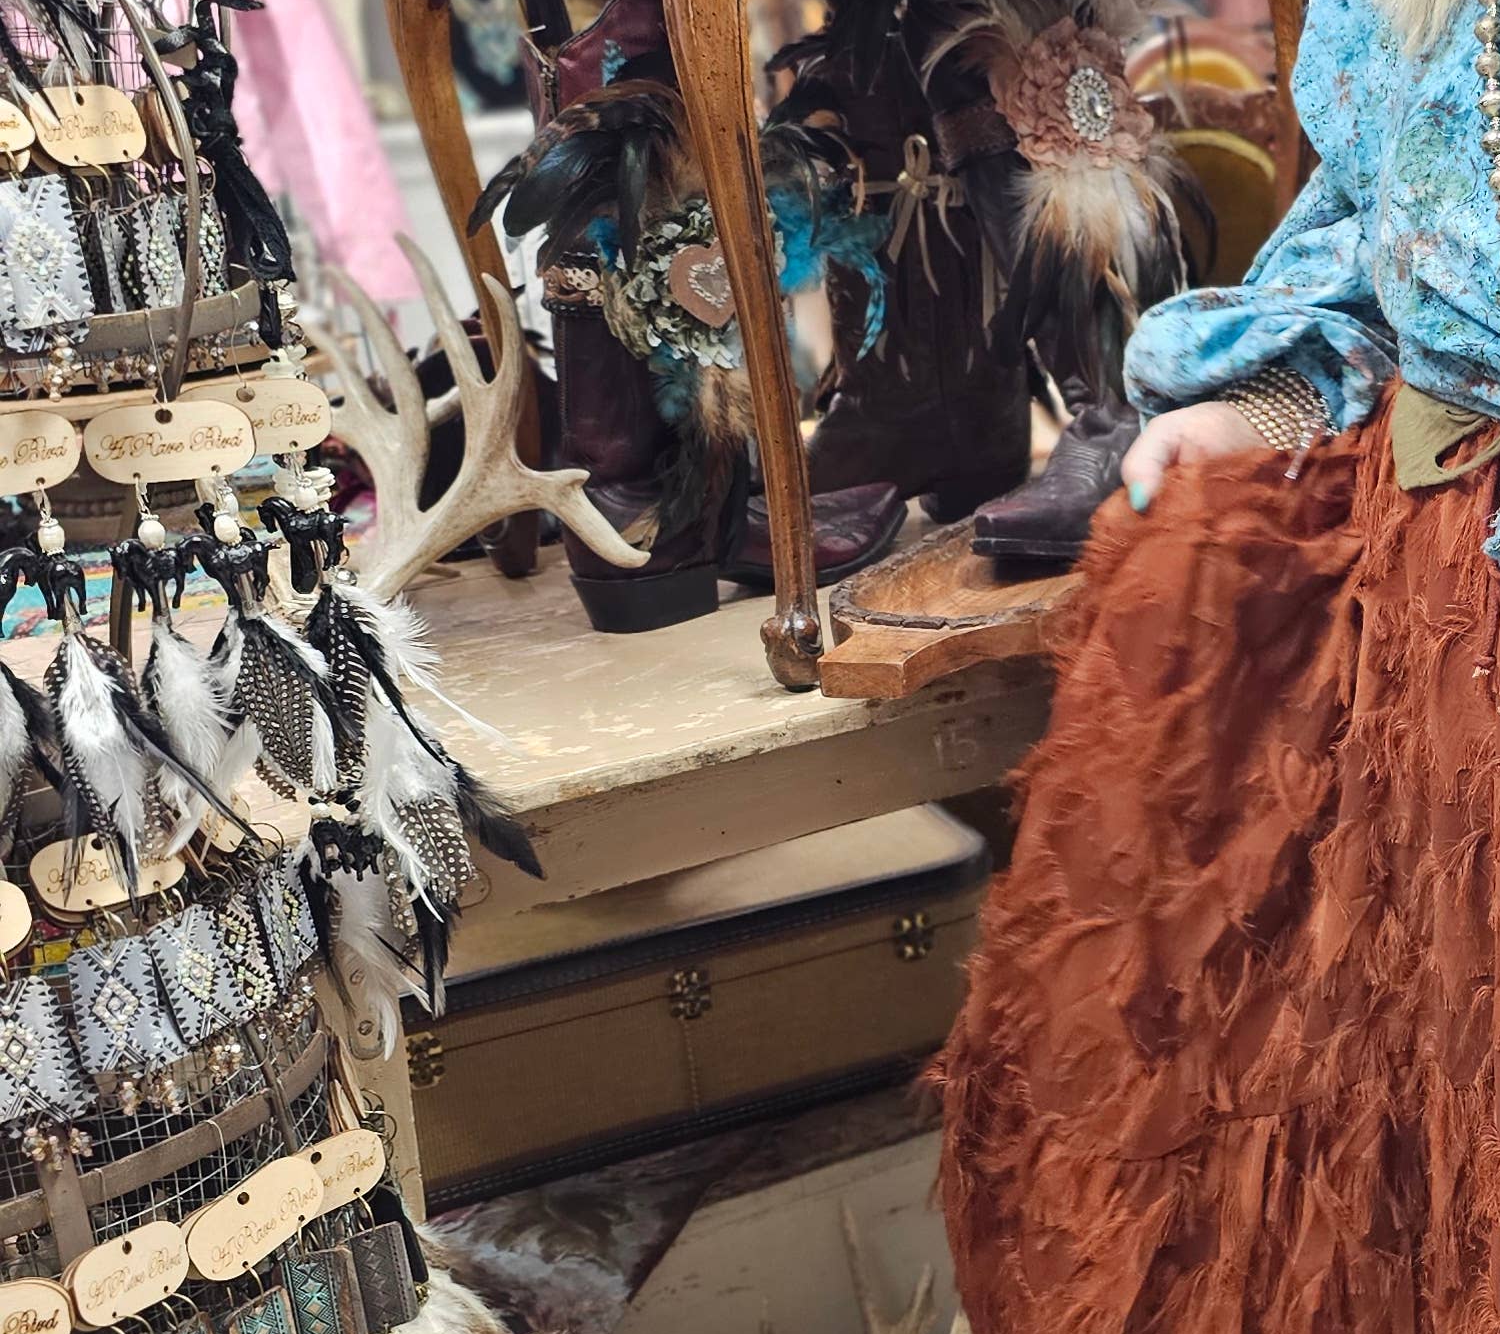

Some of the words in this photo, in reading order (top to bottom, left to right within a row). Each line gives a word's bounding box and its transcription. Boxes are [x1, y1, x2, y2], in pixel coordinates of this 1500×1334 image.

[103, 110, 136, 136] Bird
[270, 403, 322, 428] Bird
[13, 436, 69, 465] Bird
[95, 434, 134, 462] A
[130, 432, 185, 457] Rare
[190, 425, 243, 452] Bird
[336, 1147, 377, 1180] Bird
[236, 1220, 276, 1256] Rare
[279, 1179, 319, 1222] Bird
[148, 1244, 182, 1279] Bird
